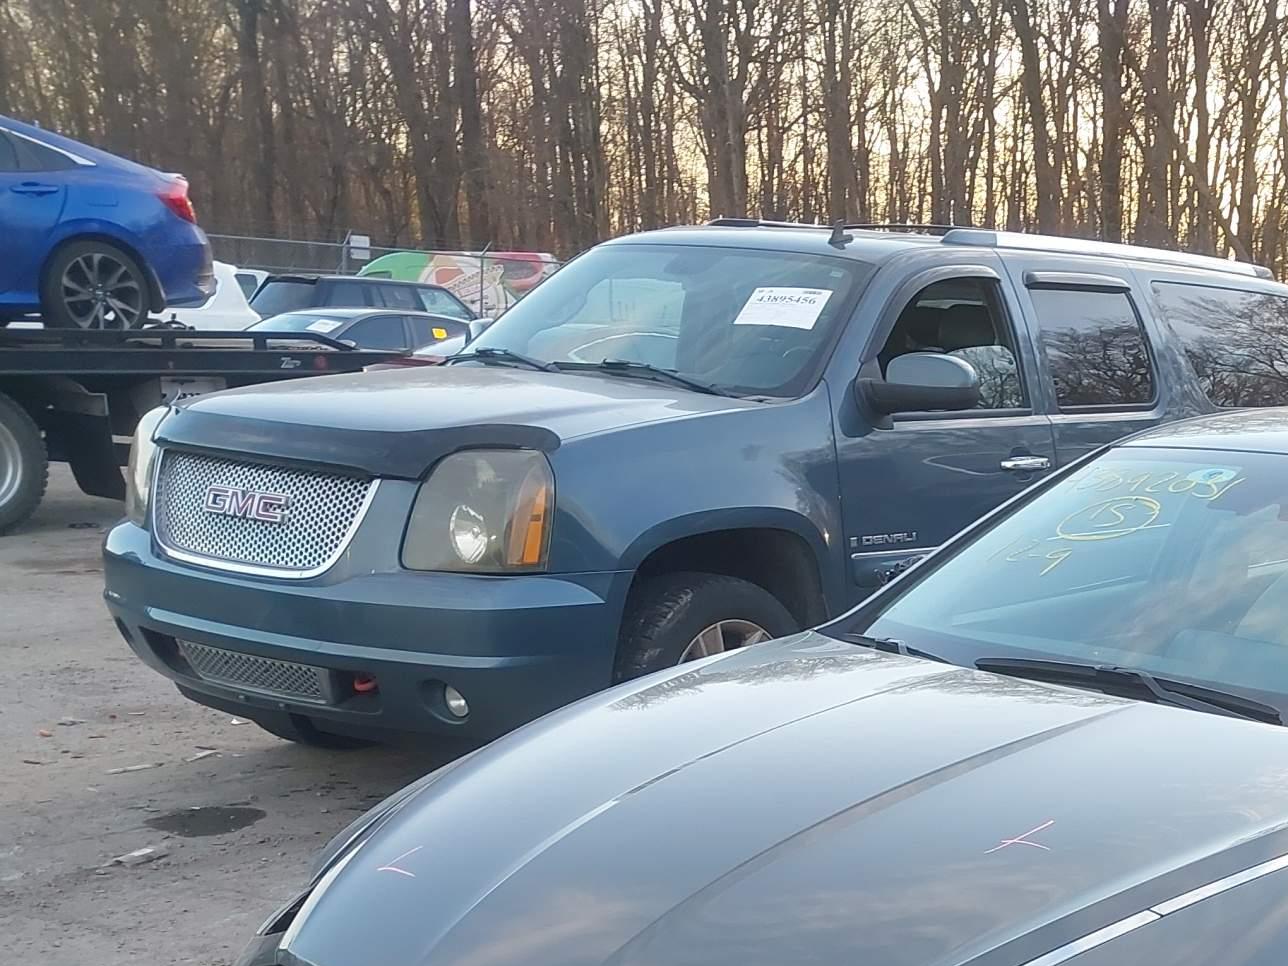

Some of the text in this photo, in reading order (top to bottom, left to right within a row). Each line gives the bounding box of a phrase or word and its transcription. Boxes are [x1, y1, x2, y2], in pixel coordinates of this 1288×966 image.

[756, 295, 817, 305] 43895456
[205, 485, 288, 523] GMC
[862, 532, 917, 546] DENALI
